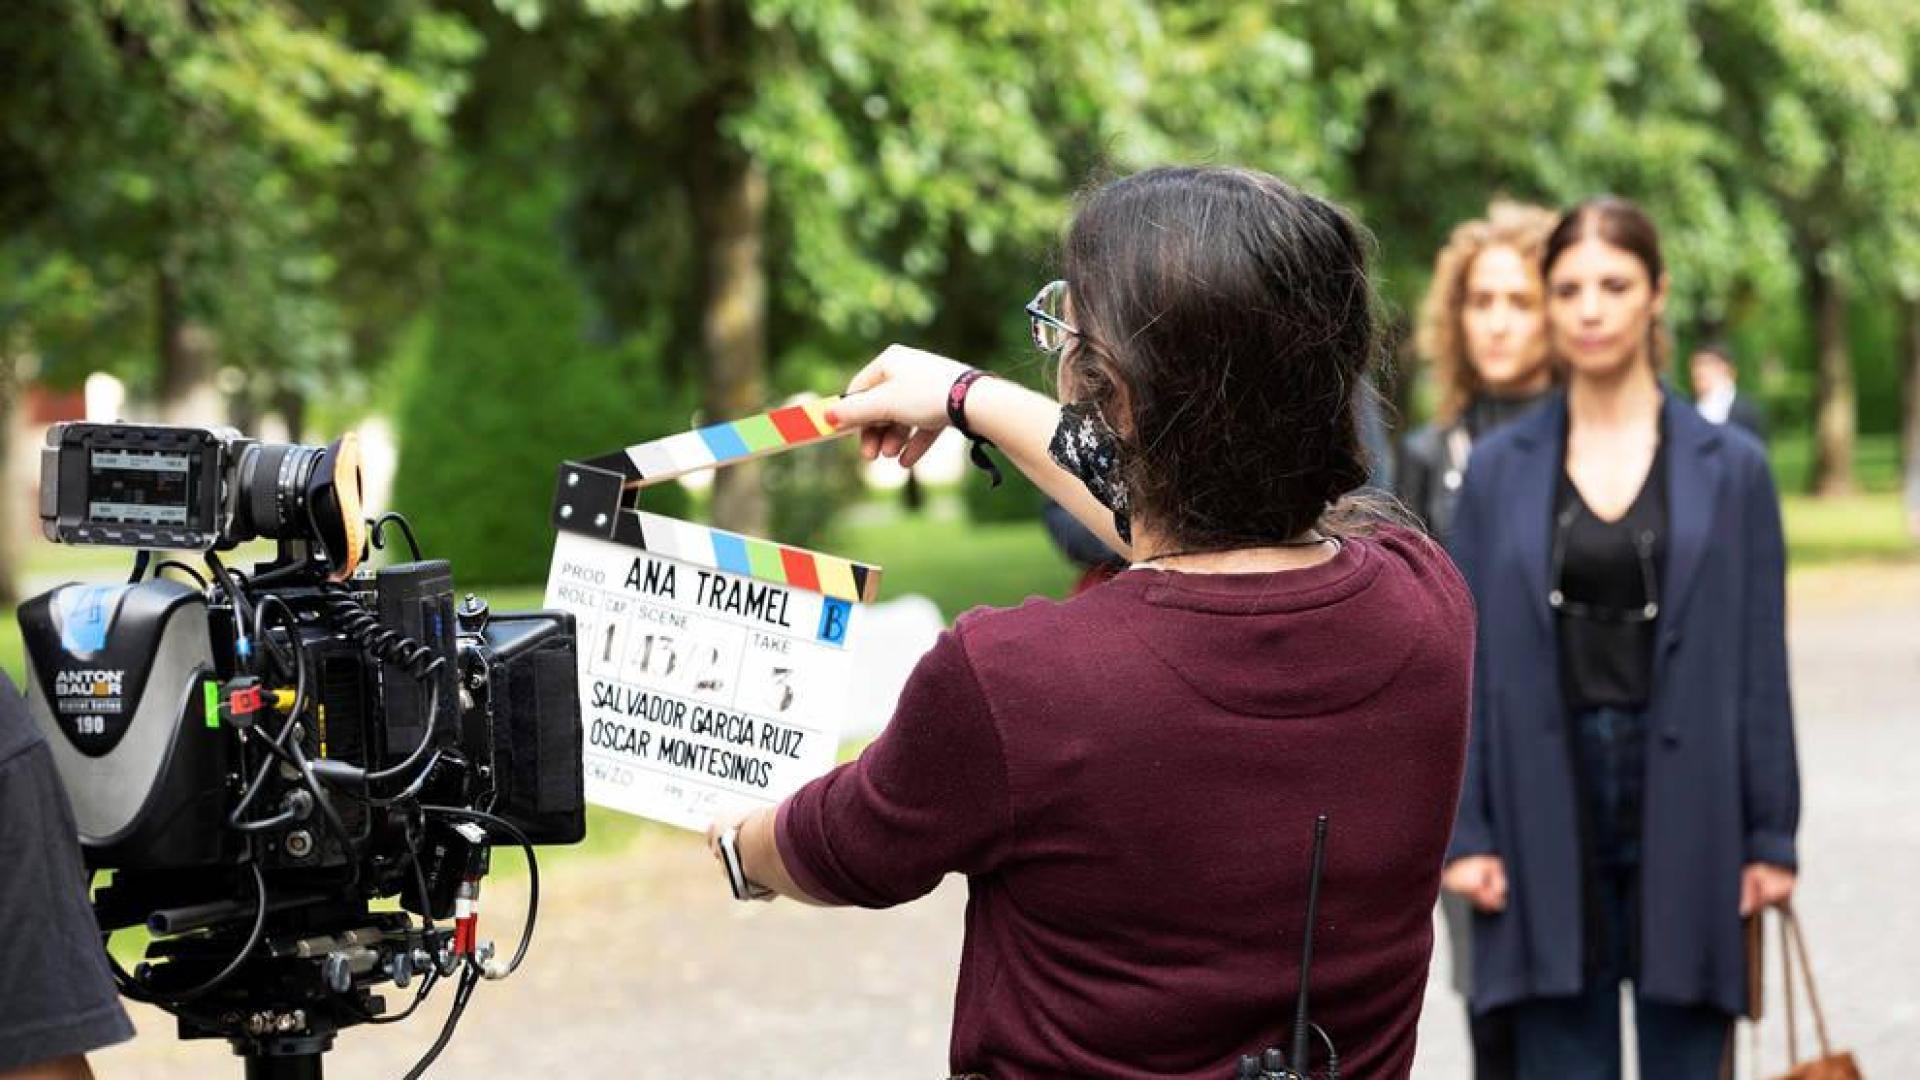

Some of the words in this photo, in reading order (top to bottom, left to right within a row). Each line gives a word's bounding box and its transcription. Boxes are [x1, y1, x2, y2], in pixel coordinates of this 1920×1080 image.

[561, 562, 605, 584] PROD
[558, 586, 595, 607] ROLL
[624, 557, 676, 599] ANA
[697, 570, 791, 628] TRAMEL
[639, 603, 688, 629] SCENE
[822, 604, 844, 643] B
[753, 632, 792, 653] TAKE
[56, 682, 122, 695] BAUR
[771, 666, 796, 713] 3
[591, 680, 687, 731] SALVADOR
[690, 704, 755, 749] GARCÍA
[759, 729, 804, 760] RUIZ
[657, 735, 773, 788] MONTESINOS
